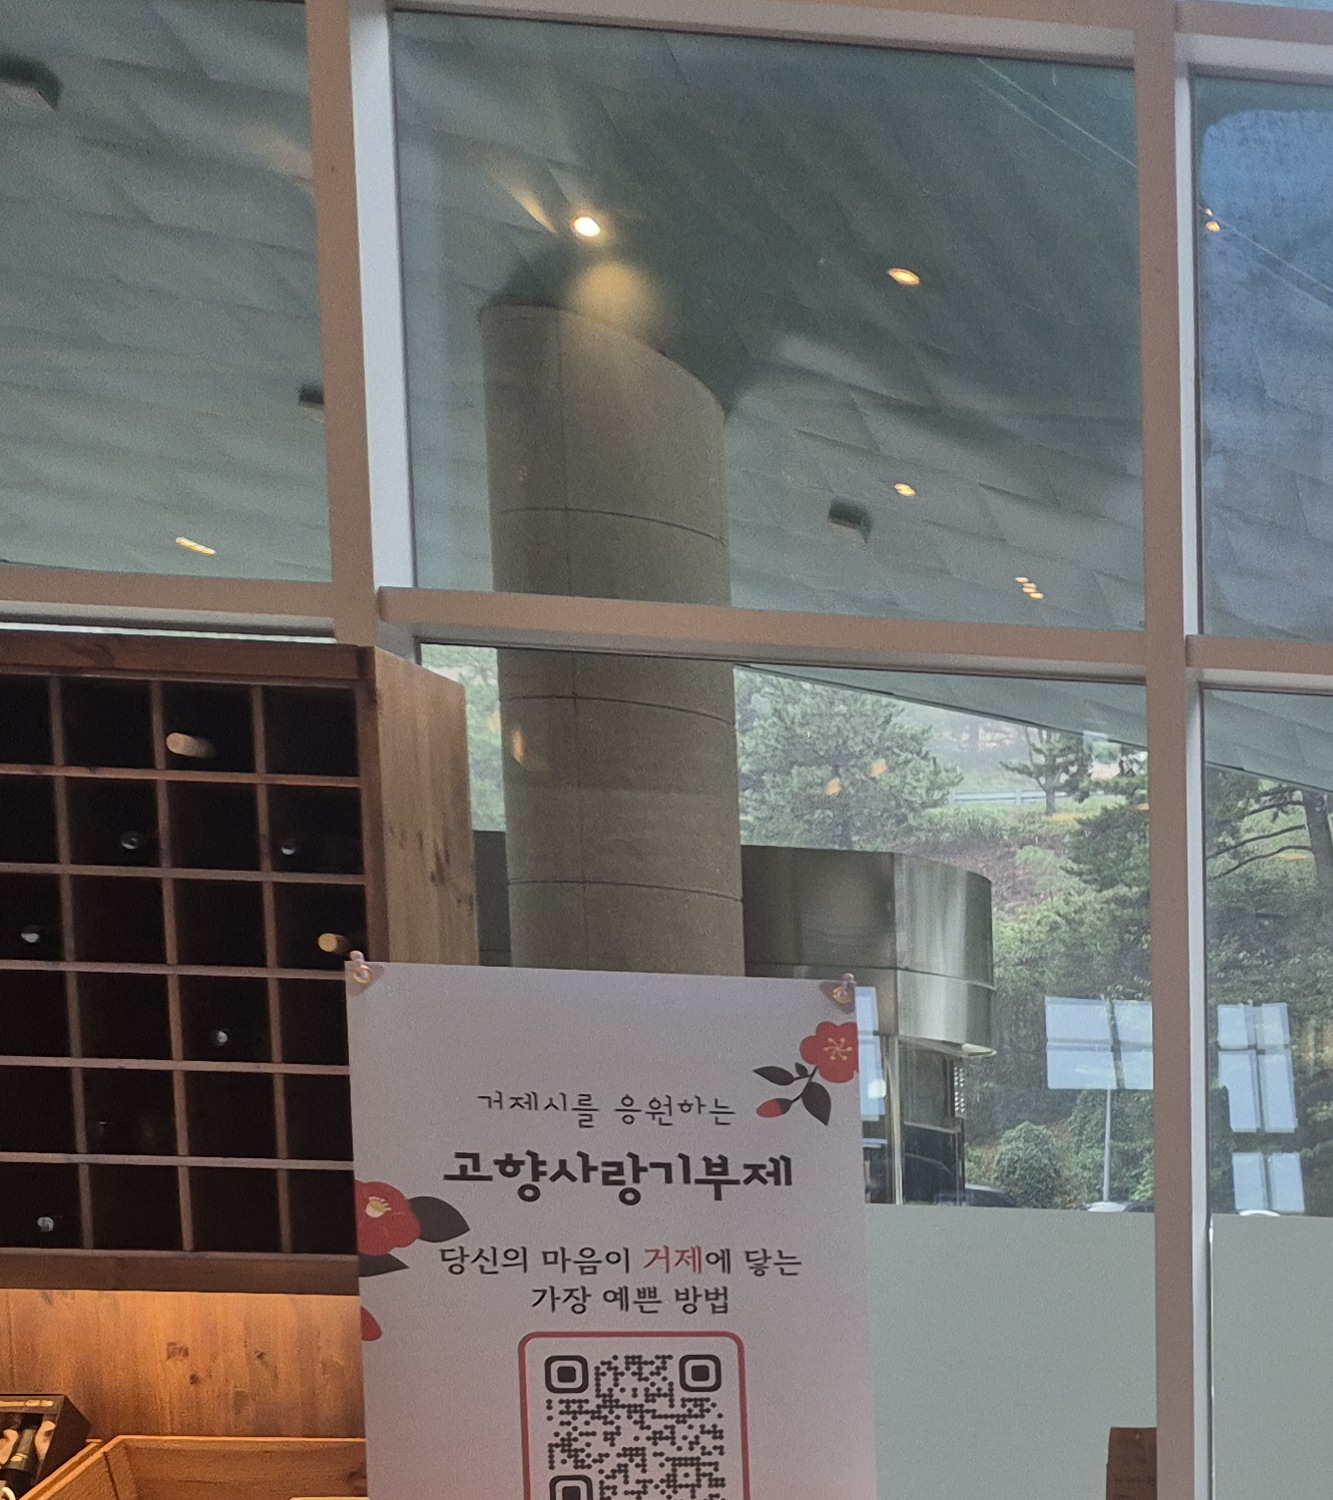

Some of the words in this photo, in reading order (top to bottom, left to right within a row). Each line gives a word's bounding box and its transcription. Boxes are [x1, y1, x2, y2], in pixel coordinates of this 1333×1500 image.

[477, 1090, 599, 1128] 거제시를
[614, 1093, 736, 1127] 응원하는
[443, 1149, 793, 1206] 고향사랑기부제
[440, 1246, 528, 1275] 당신의
[542, 1246, 630, 1275] 마음이
[643, 1245, 731, 1275] 거제에
[744, 1248, 802, 1277] 닿는
[531, 1285, 592, 1315] 가장
[603, 1285, 663, 1314] 예쁜
[674, 1285, 729, 1315] 방법
